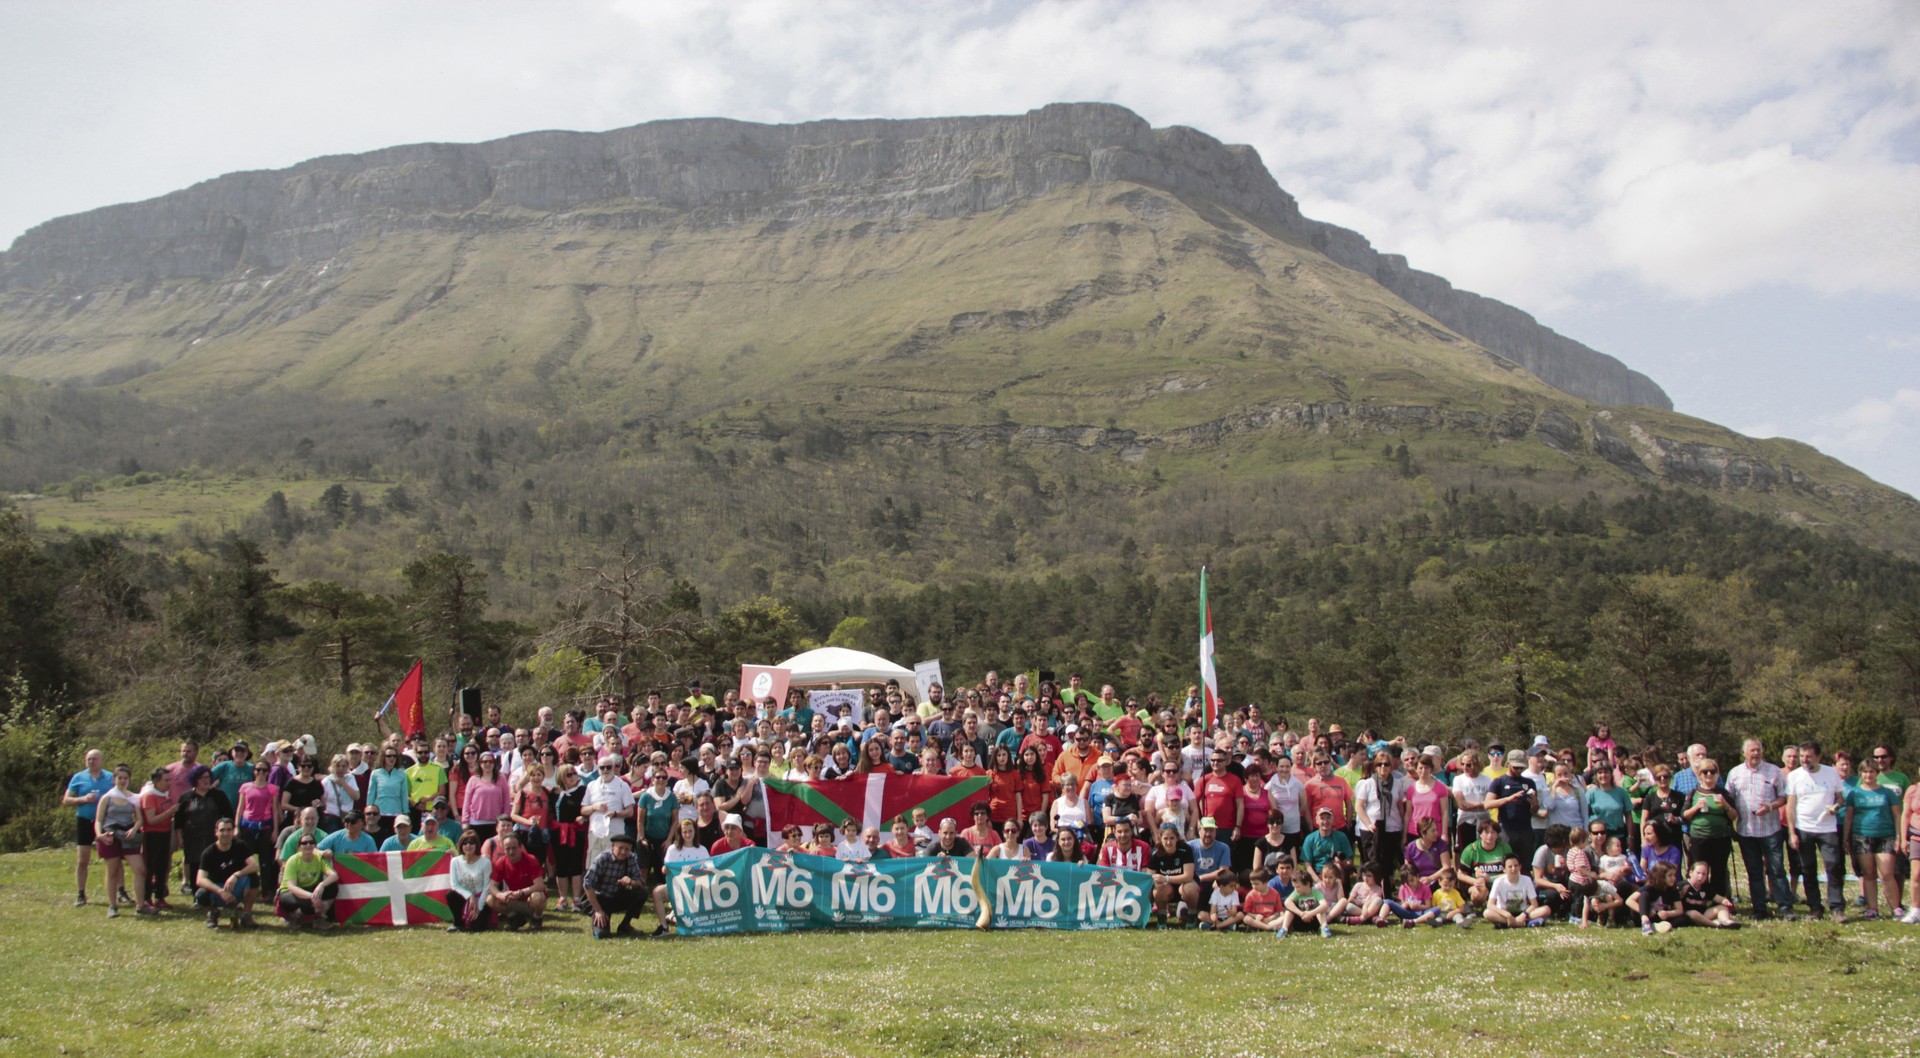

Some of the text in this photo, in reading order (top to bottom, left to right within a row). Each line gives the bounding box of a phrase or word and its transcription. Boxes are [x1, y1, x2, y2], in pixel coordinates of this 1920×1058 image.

[672, 868, 739, 916] M6
[751, 865, 813, 908] M6
[831, 872, 896, 912] M6
[914, 874, 978, 914] M6
[995, 877, 1060, 918] M6
[1077, 882, 1142, 922] M6
